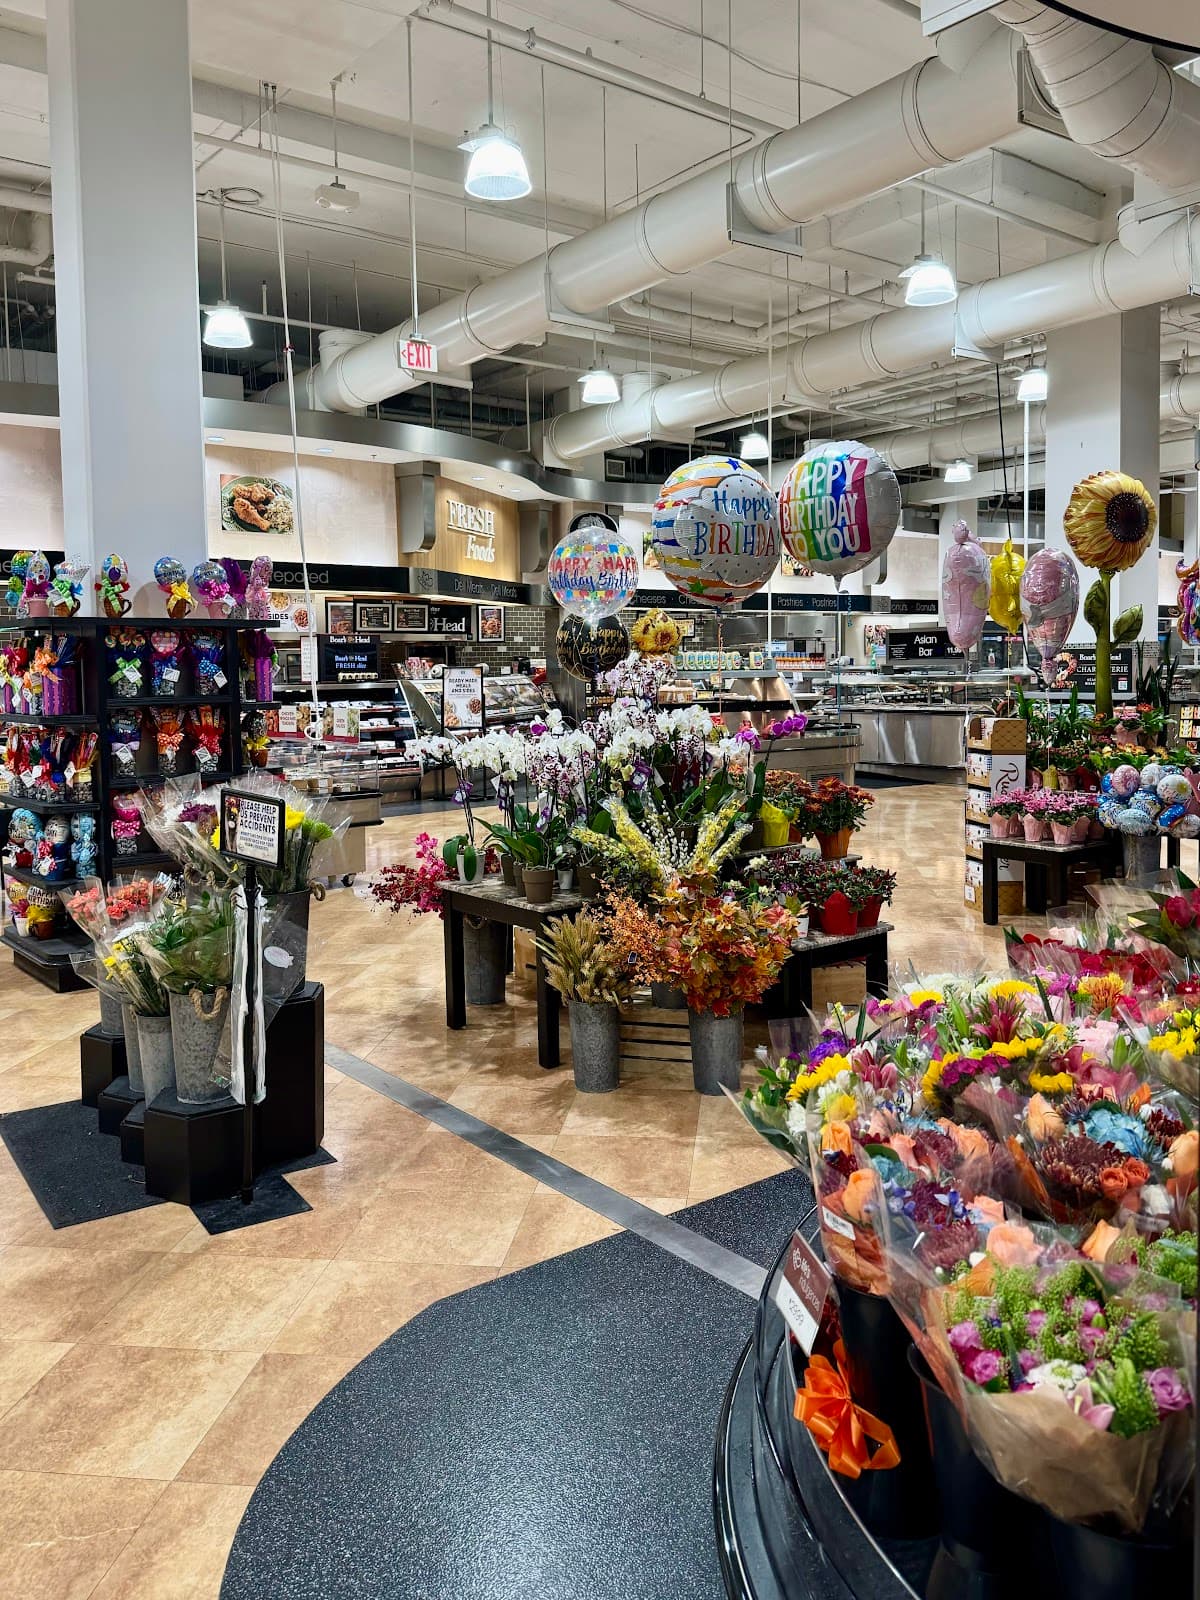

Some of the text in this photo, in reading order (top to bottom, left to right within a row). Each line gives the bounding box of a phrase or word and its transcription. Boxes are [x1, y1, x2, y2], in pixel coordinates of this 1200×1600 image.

[406, 342, 433, 369] EXIT
[781, 459, 860, 501] HAPPY
[712, 489, 772, 521] Happy
[782, 492, 859, 533] BIRTHDAY
[447, 500, 496, 535] FRESH
[465, 534, 496, 563] Foods
[785, 525, 861, 558] TO YOU
[602, 556, 637, 570] HAPP
[434, 616, 466, 633] Head
[913, 634, 938, 645] Asian
[918, 646, 934, 657] Bar
[240, 800, 277, 814] PLEASE HELP
[240, 810, 276, 825] US PREVENT
[240, 819, 276, 834] ACCIDENTS
